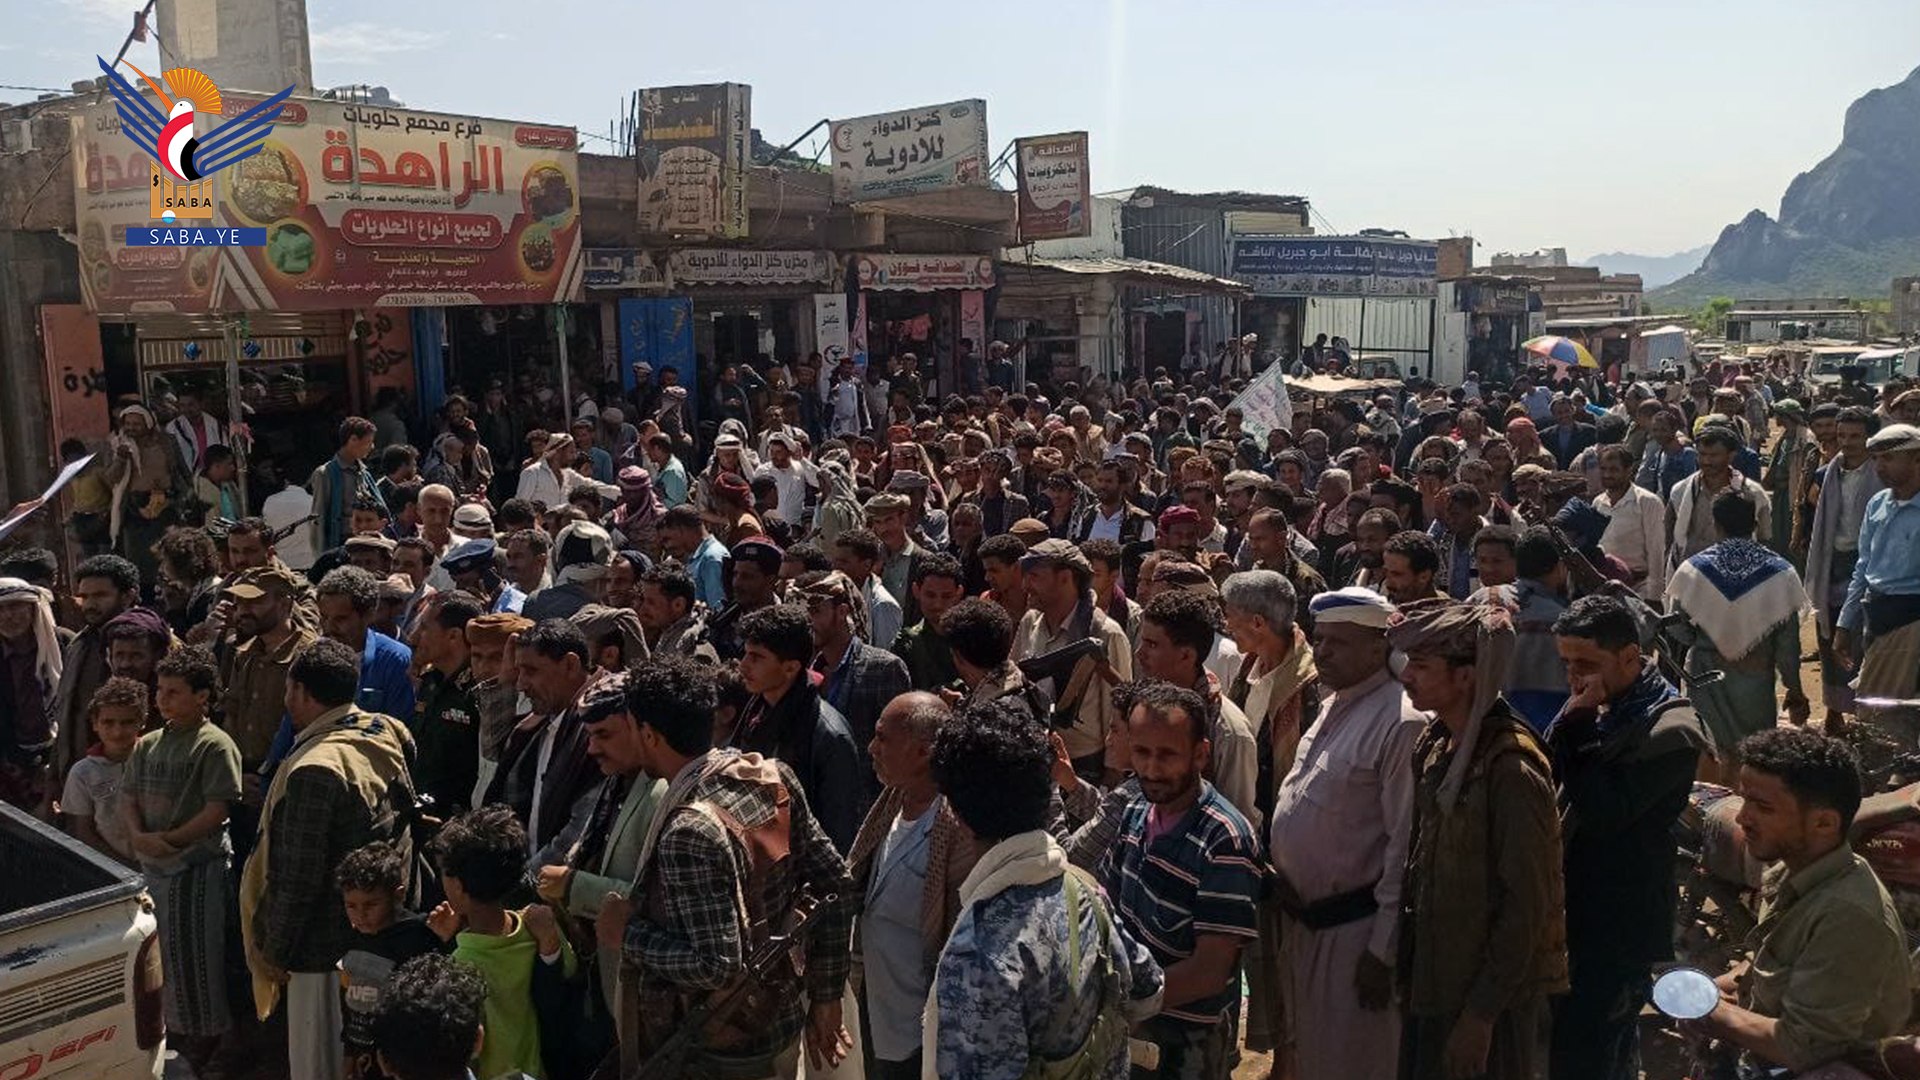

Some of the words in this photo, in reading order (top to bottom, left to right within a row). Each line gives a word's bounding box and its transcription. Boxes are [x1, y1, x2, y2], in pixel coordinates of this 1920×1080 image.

[343, 108, 400, 129] حلويات
[405, 115, 450, 134] مجمع
[454, 119, 483, 139] فرع
[871, 115, 911, 137] الدواء
[915, 109, 942, 132] كنز
[321, 128, 504, 210] الراهدة
[352, 213, 413, 240] الحلويات
[417, 215, 450, 242] أنواع
[454, 220, 492, 245] لجميع
[732, 253, 762, 271] الدواء
[765, 253, 782, 270] كنز
[784, 252, 808, 270] مخزن
